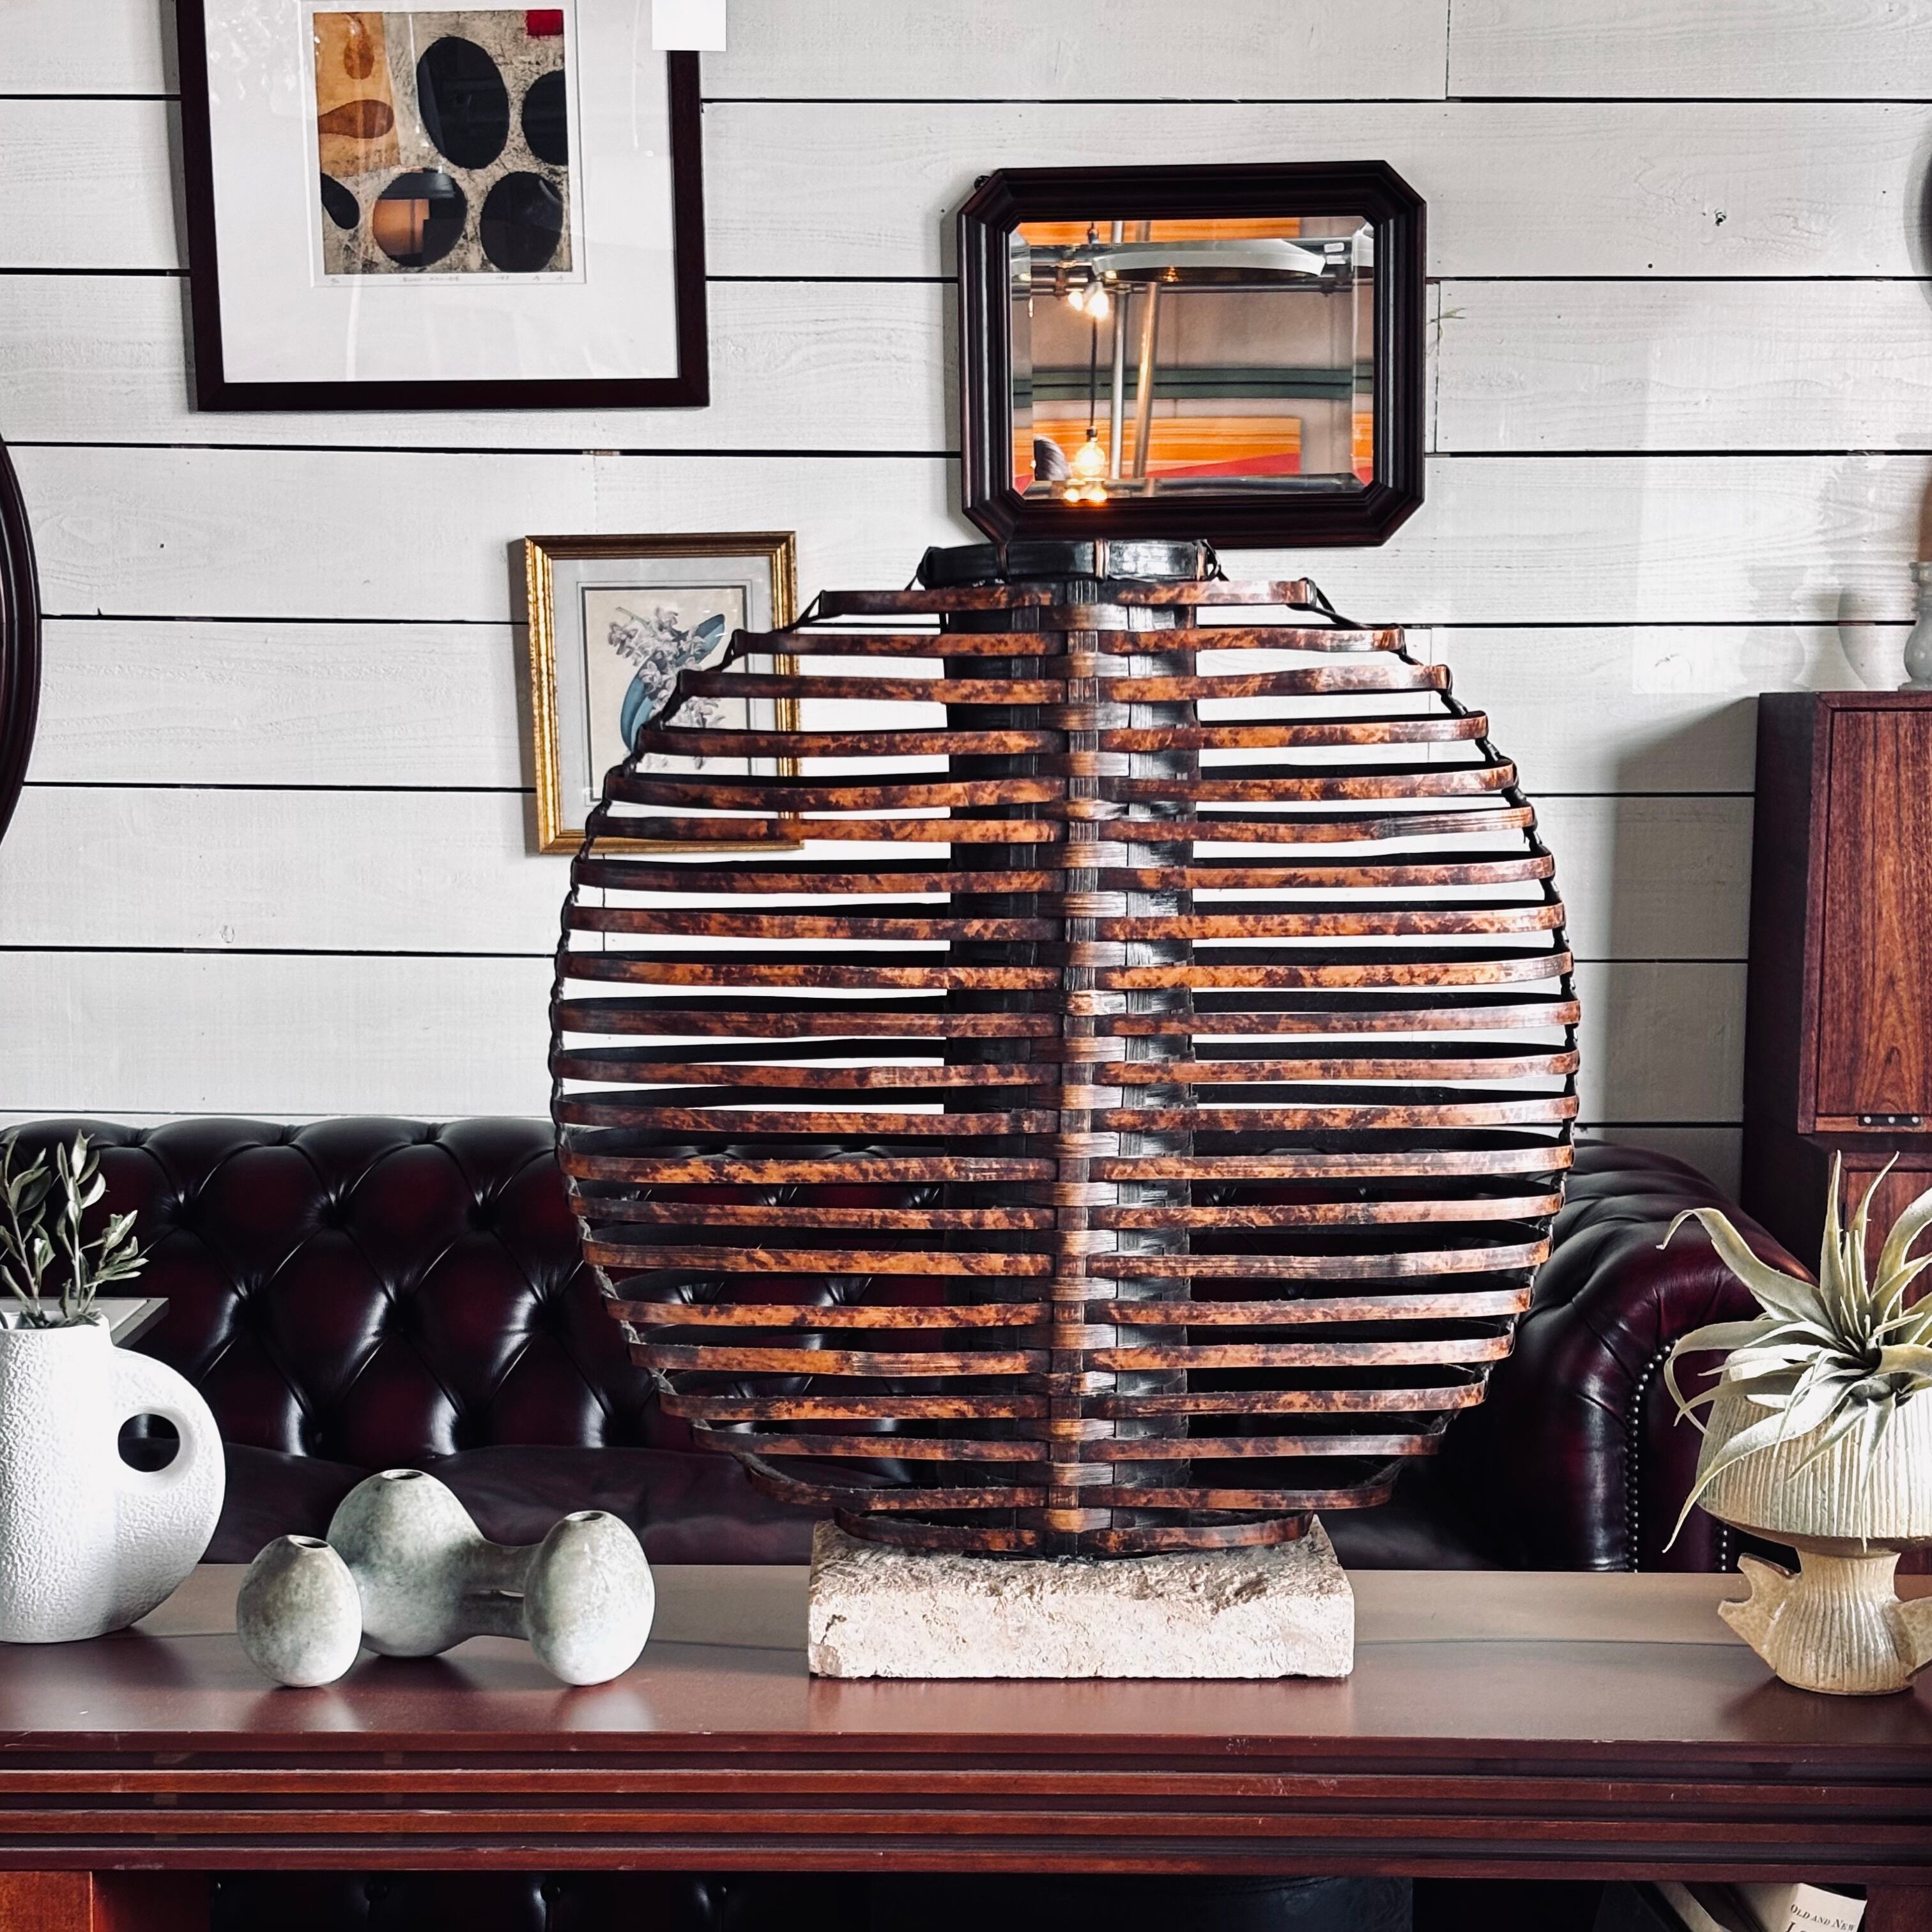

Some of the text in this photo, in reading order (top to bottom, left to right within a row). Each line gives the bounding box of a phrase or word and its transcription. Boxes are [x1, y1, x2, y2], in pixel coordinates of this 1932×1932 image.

[1790, 1904, 1856, 1931] OLD AND NEW
